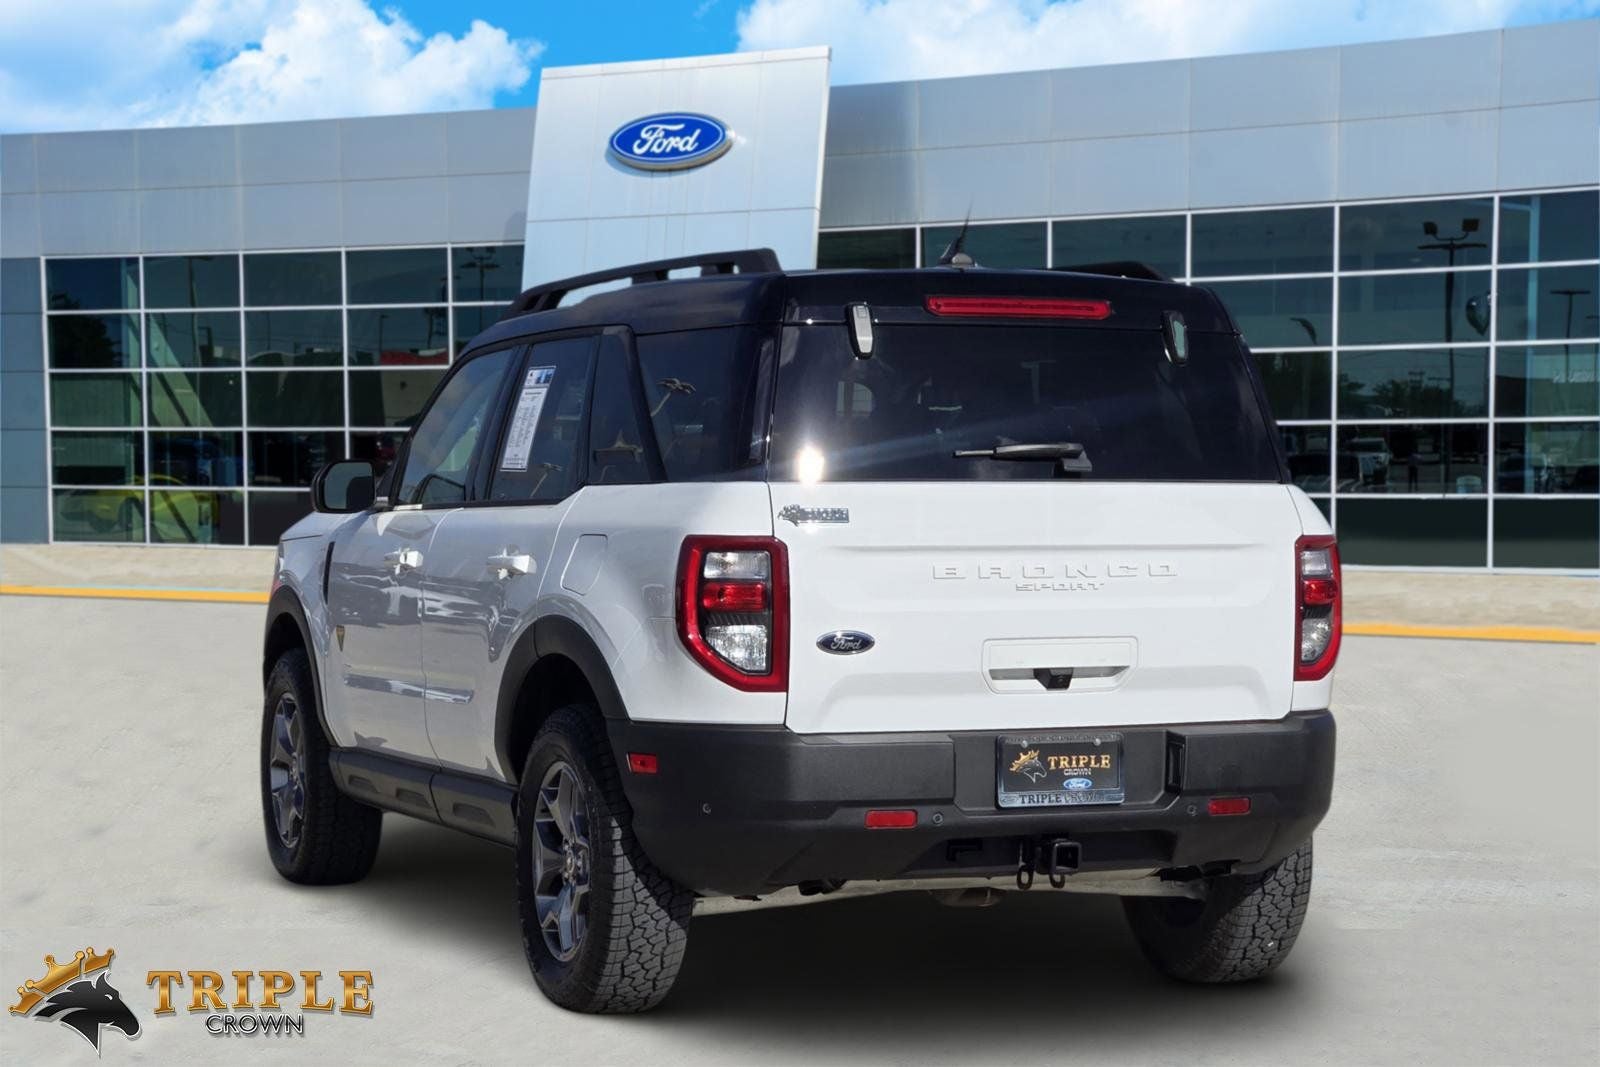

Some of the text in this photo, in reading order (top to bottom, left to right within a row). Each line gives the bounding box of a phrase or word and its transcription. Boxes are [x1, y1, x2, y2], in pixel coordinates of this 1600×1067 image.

[632, 123, 701, 155] Ford
[932, 562, 1178, 580] BRONCO
[1015, 582, 1105, 592] SPORT
[830, 636, 862, 650] Ford
[1047, 754, 1111, 770] TRIPLE
[1063, 768, 1092, 776] CROWN
[1019, 793, 1062, 804] TRIPLE
